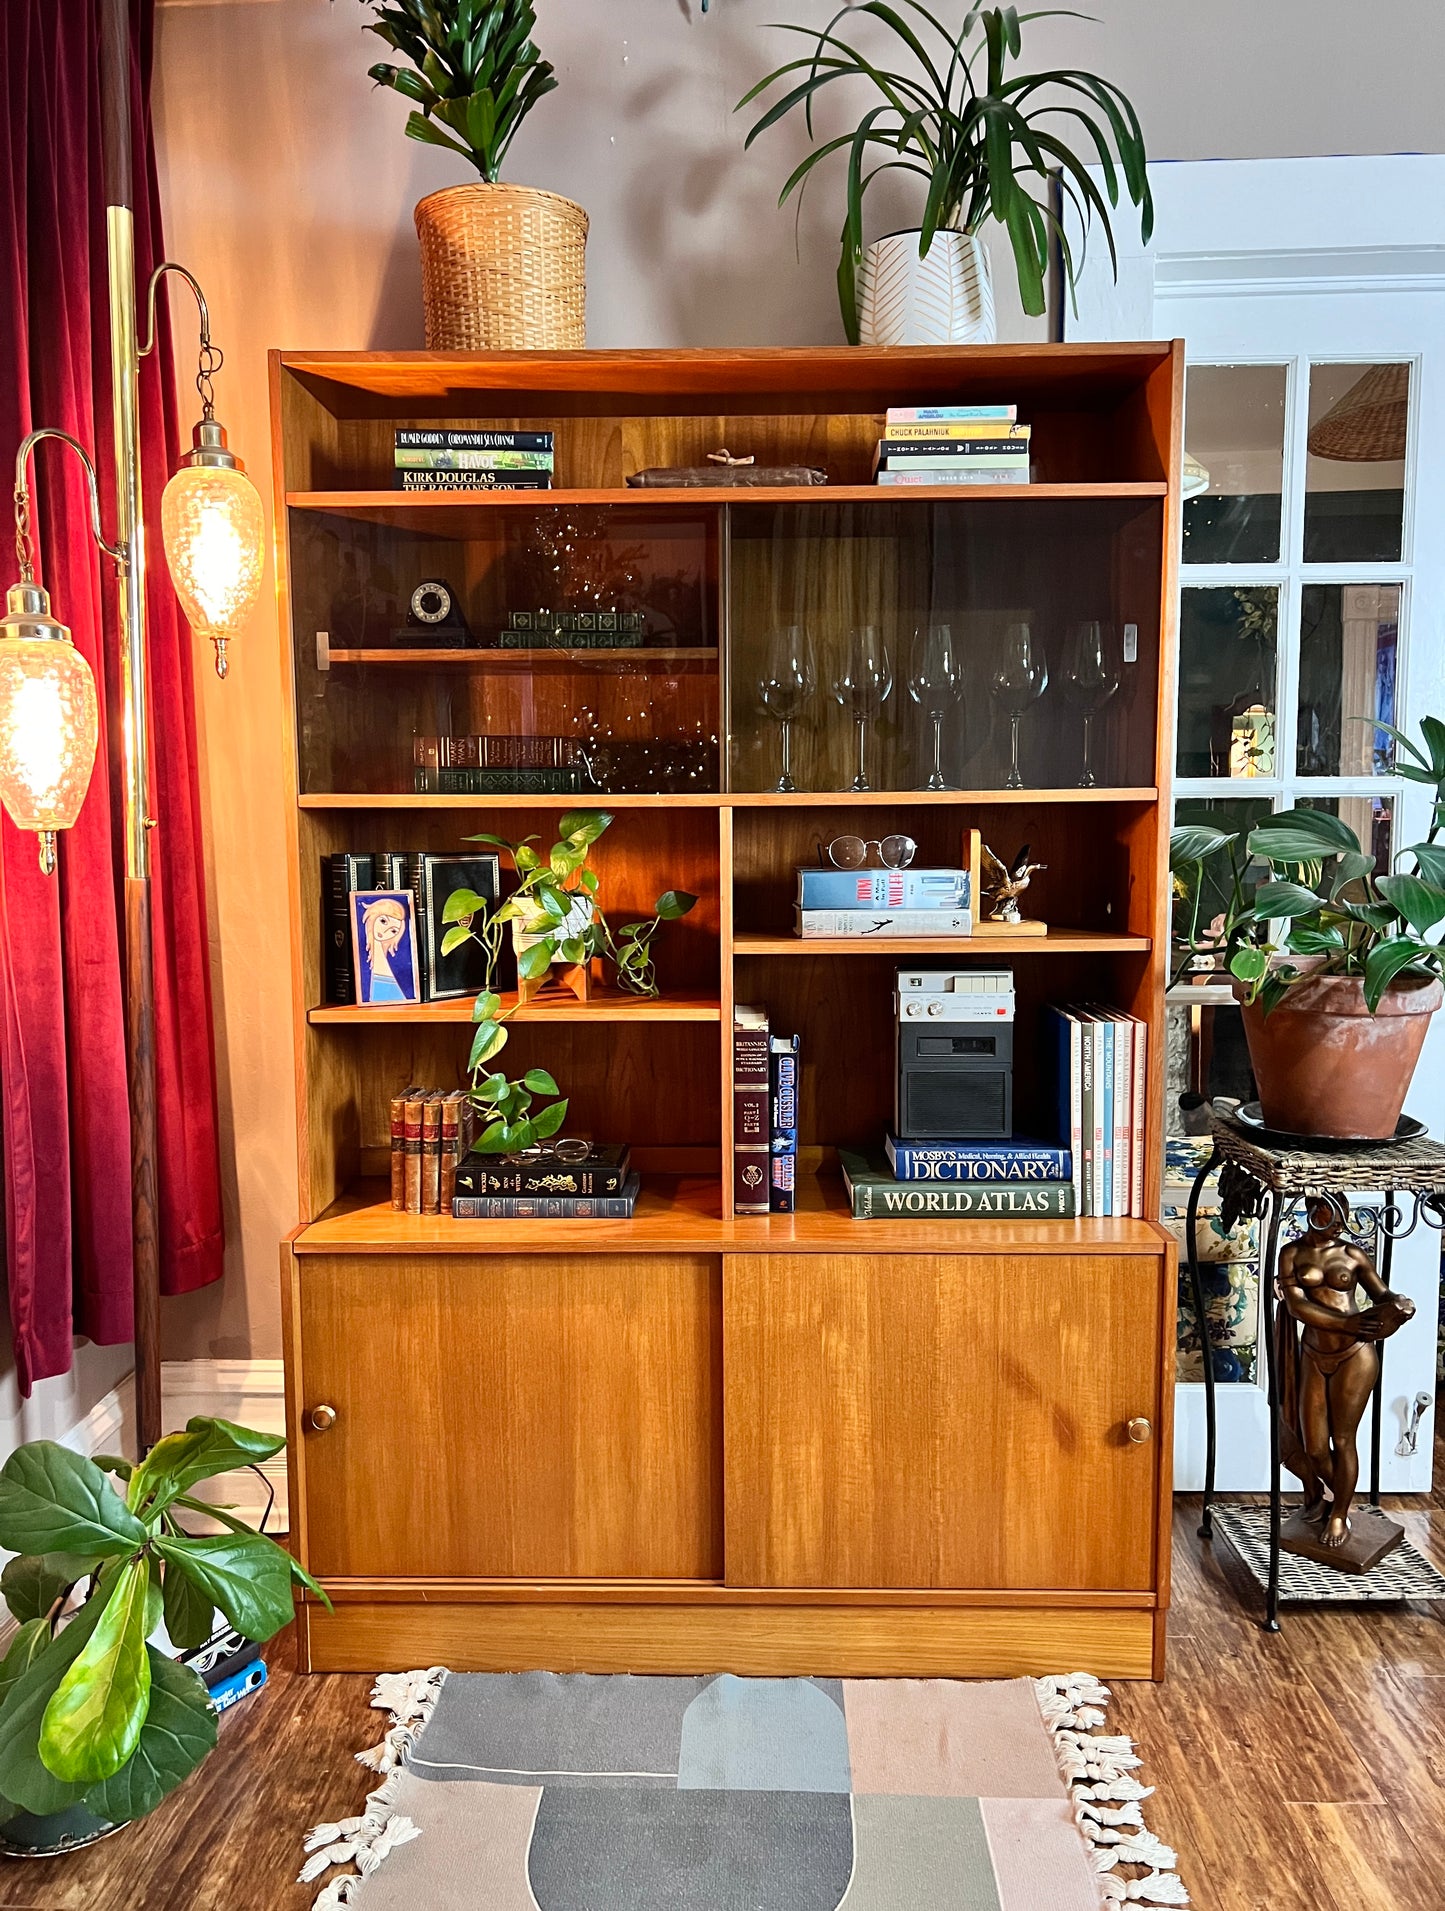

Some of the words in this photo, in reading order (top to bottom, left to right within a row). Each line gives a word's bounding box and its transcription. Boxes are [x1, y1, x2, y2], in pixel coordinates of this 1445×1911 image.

[400, 433, 420, 444] RUMER
[421, 433, 444, 444] GODDEN
[448, 434, 484, 445] COROMANDEL
[484, 434, 494, 447] SEA
[495, 434, 515, 446] CHANGE
[914, 428, 950, 436] PALAHNIUK
[458, 452, 498, 469] HAVOC
[403, 472, 433, 482] KIRK
[436, 472, 496, 483] DOUGLAS
[857, 879, 872, 901] TOM
[888, 873, 903, 906] WOLFE
[780, 1058, 794, 1086] CLIVE
[780, 1087, 794, 1128] CUSSLER
[912, 1152, 956, 1160] MOSBY'S
[772, 1157, 783, 1188] SHIFT
[783, 1155, 794, 1191] POLAR
[912, 1161, 1054, 1180] DICTIONARY
[883, 1191, 973, 1212] WORLD
[976, 1191, 1050, 1211] ATLAS
